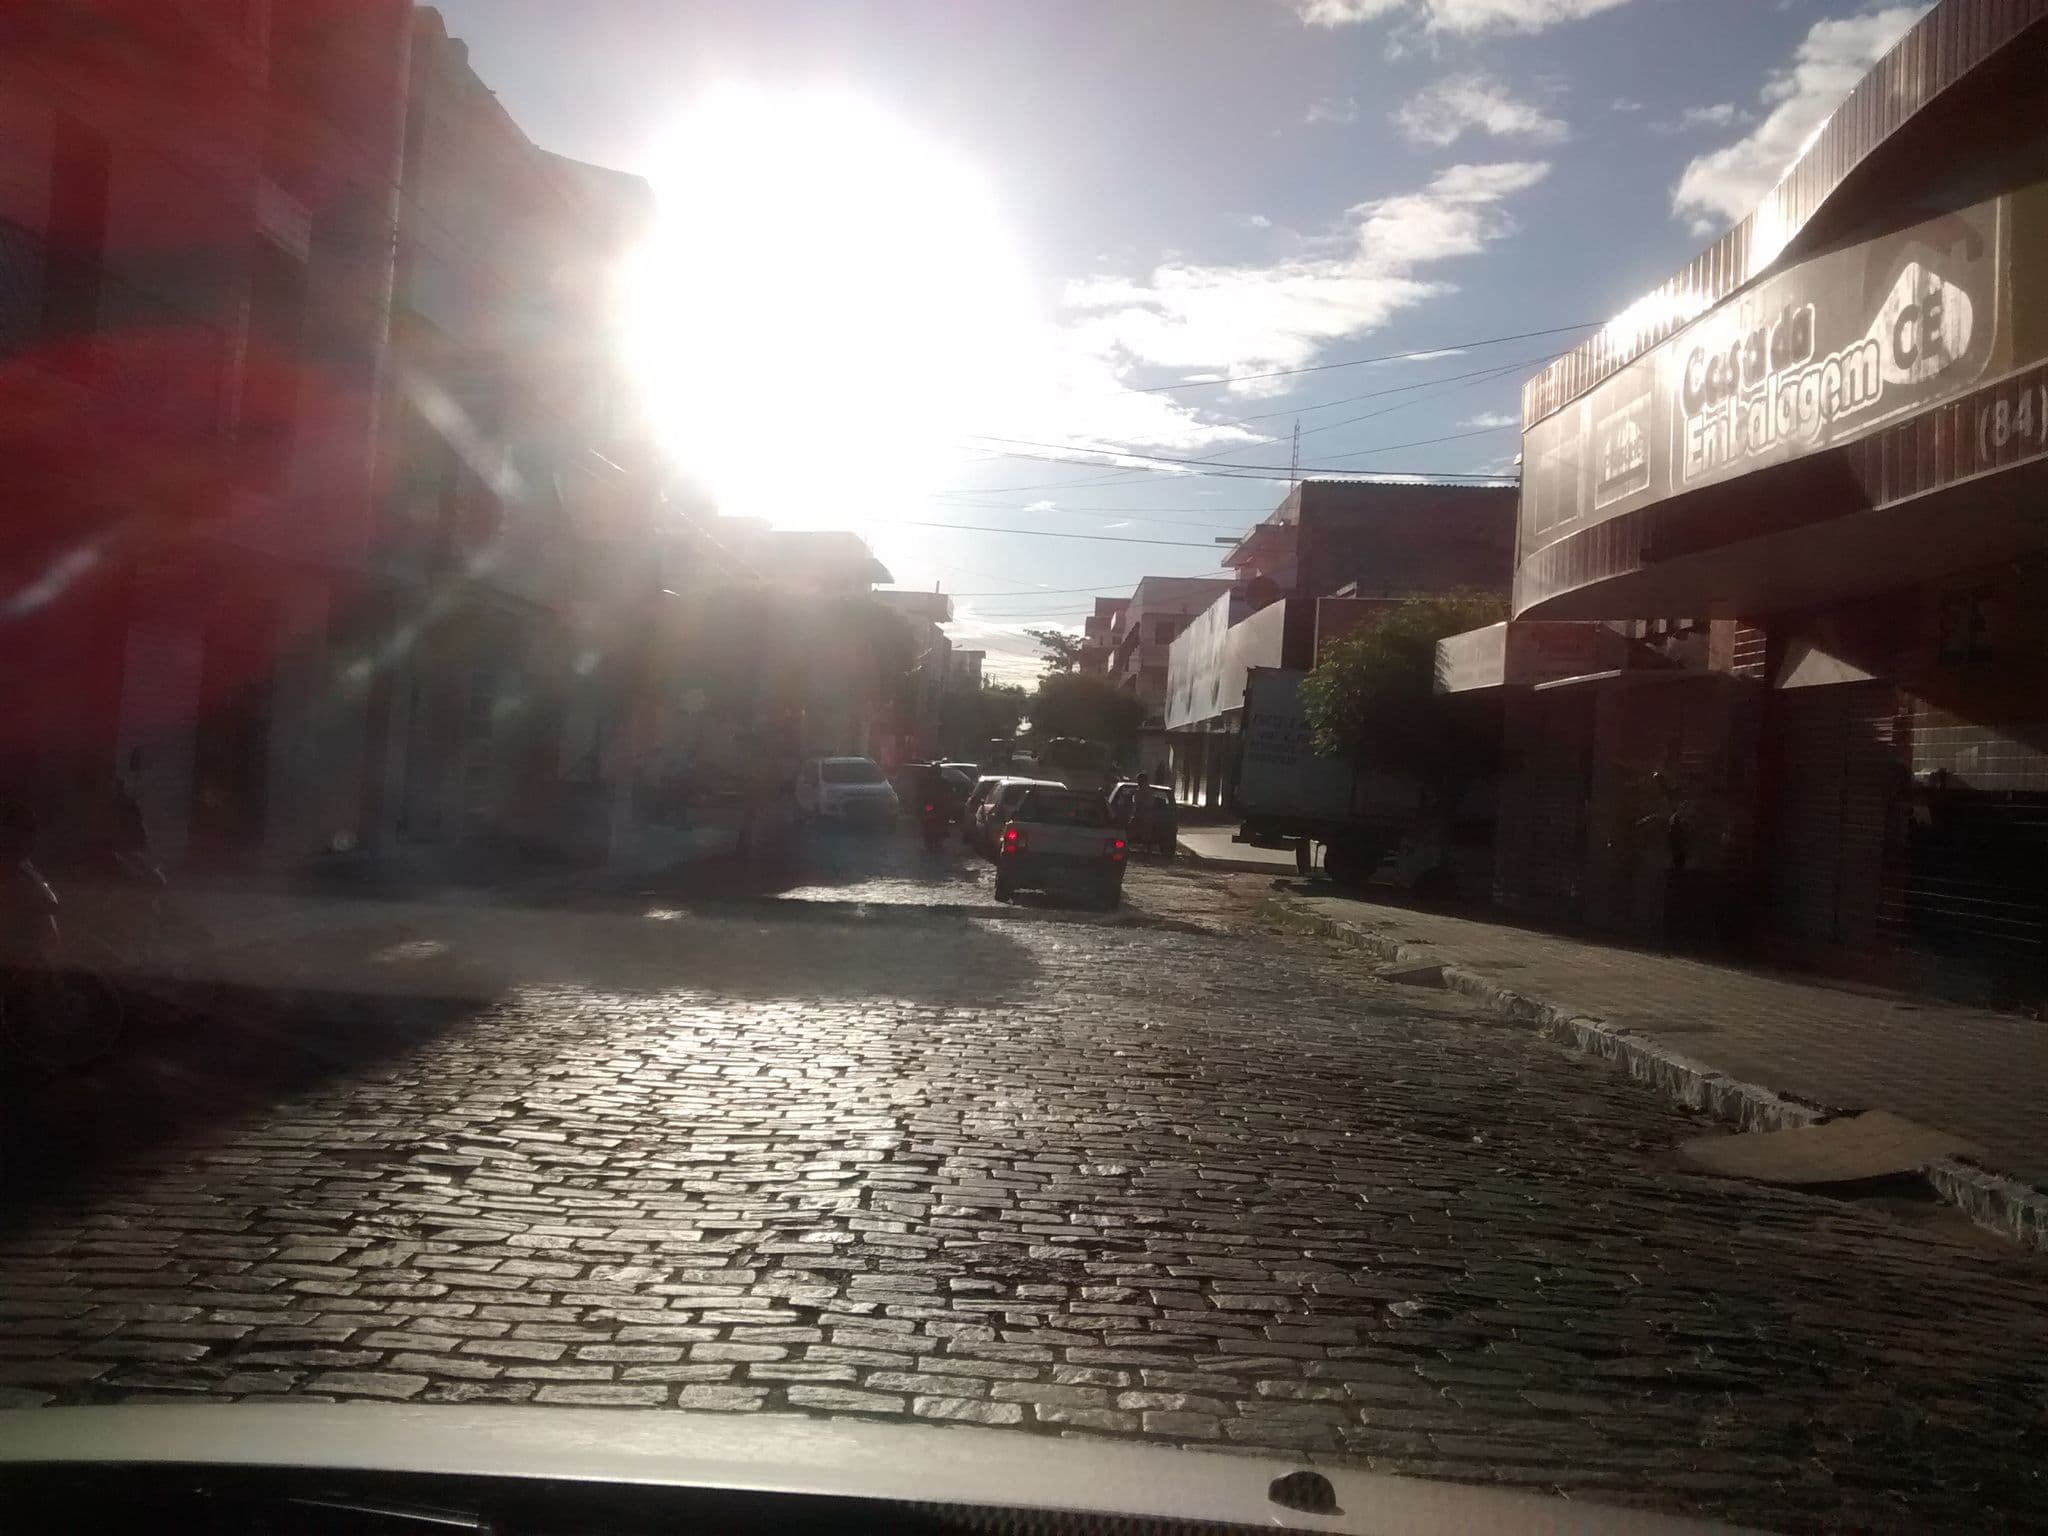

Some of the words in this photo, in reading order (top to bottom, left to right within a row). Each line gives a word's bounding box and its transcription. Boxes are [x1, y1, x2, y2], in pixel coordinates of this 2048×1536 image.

[1682, 326, 1767, 416] Casa
[1892, 285, 1943, 370] CE
[1685, 339, 1881, 480] Embalagem
